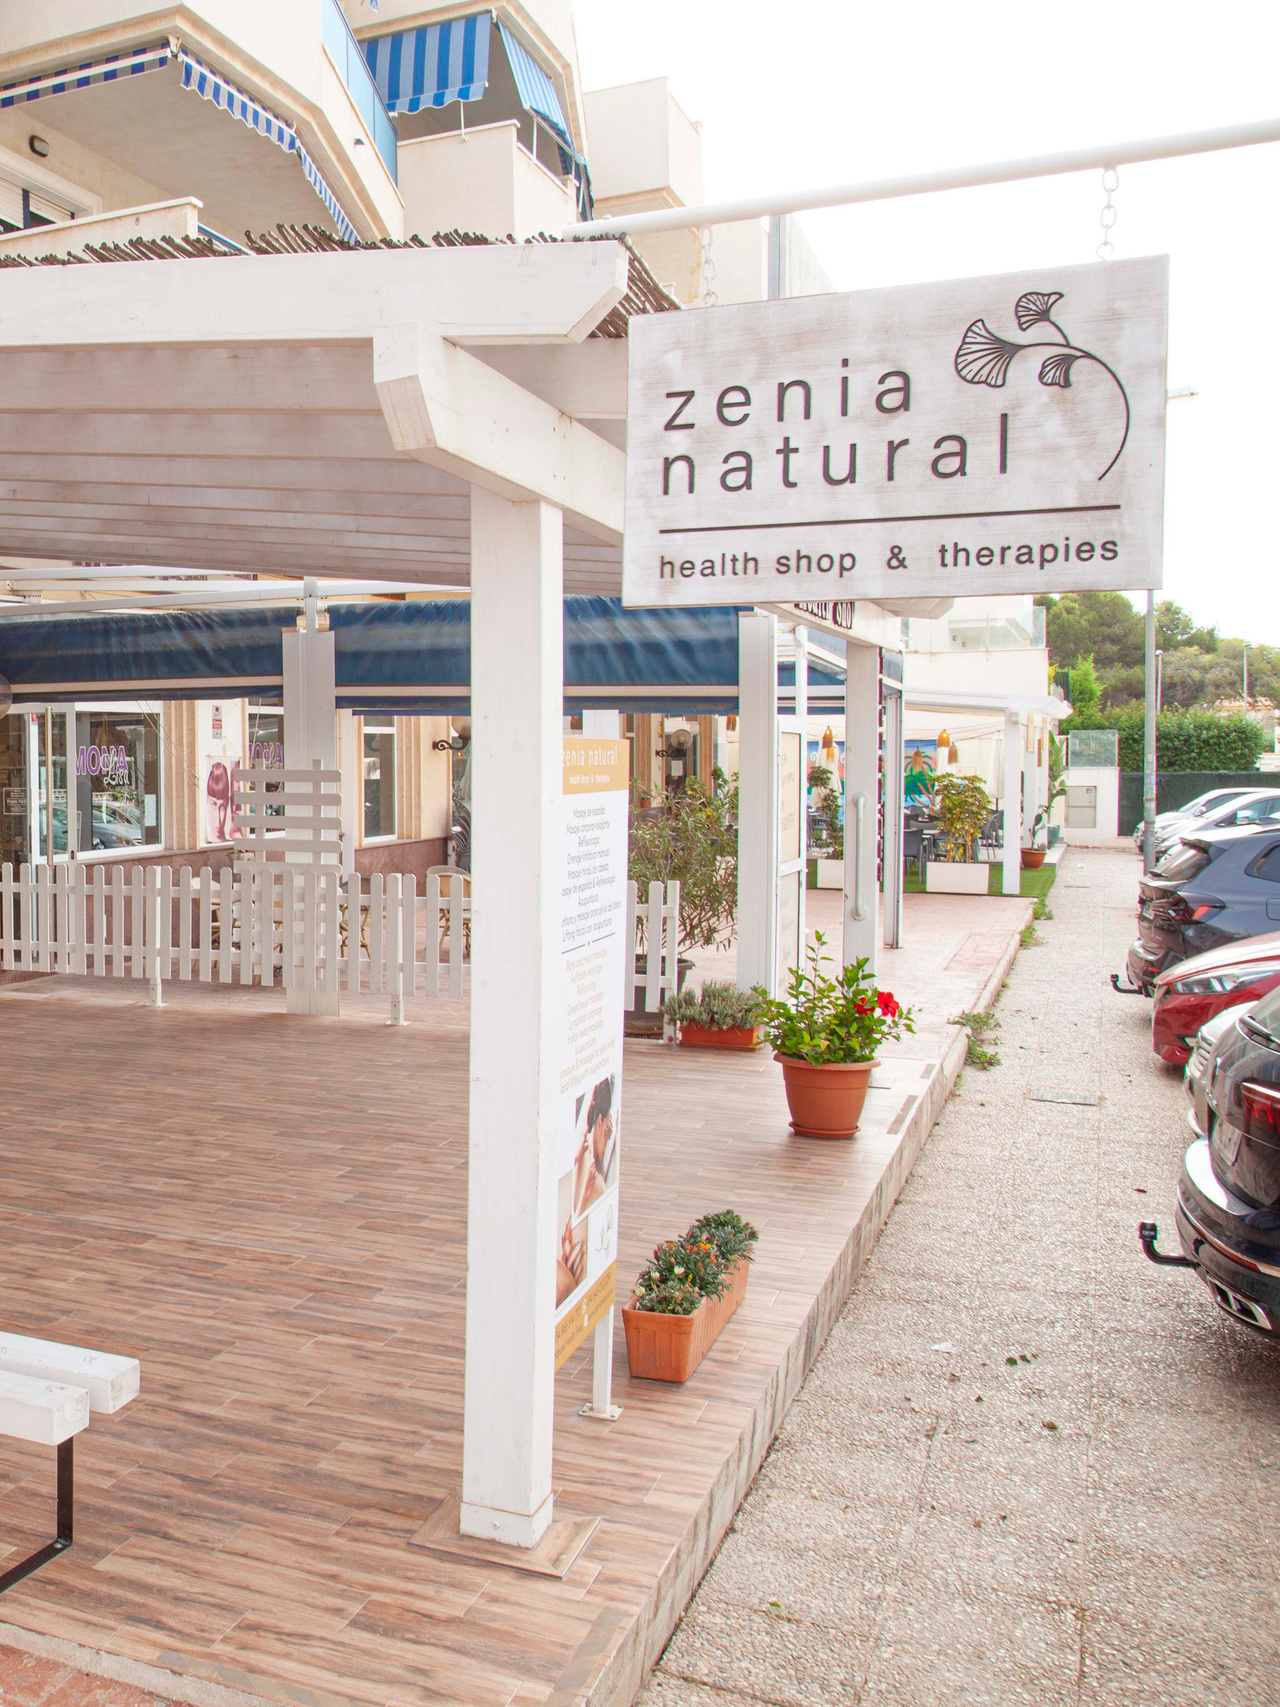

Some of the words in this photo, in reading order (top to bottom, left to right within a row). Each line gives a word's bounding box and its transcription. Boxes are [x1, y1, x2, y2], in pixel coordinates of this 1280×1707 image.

[663, 359, 912, 431] zenia
[662, 413, 1008, 496] natural
[660, 550, 759, 579] health
[776, 548, 857, 579] shop
[887, 545, 908, 570] &
[940, 537, 1119, 570] therapies
[589, 745, 618, 766] natural
